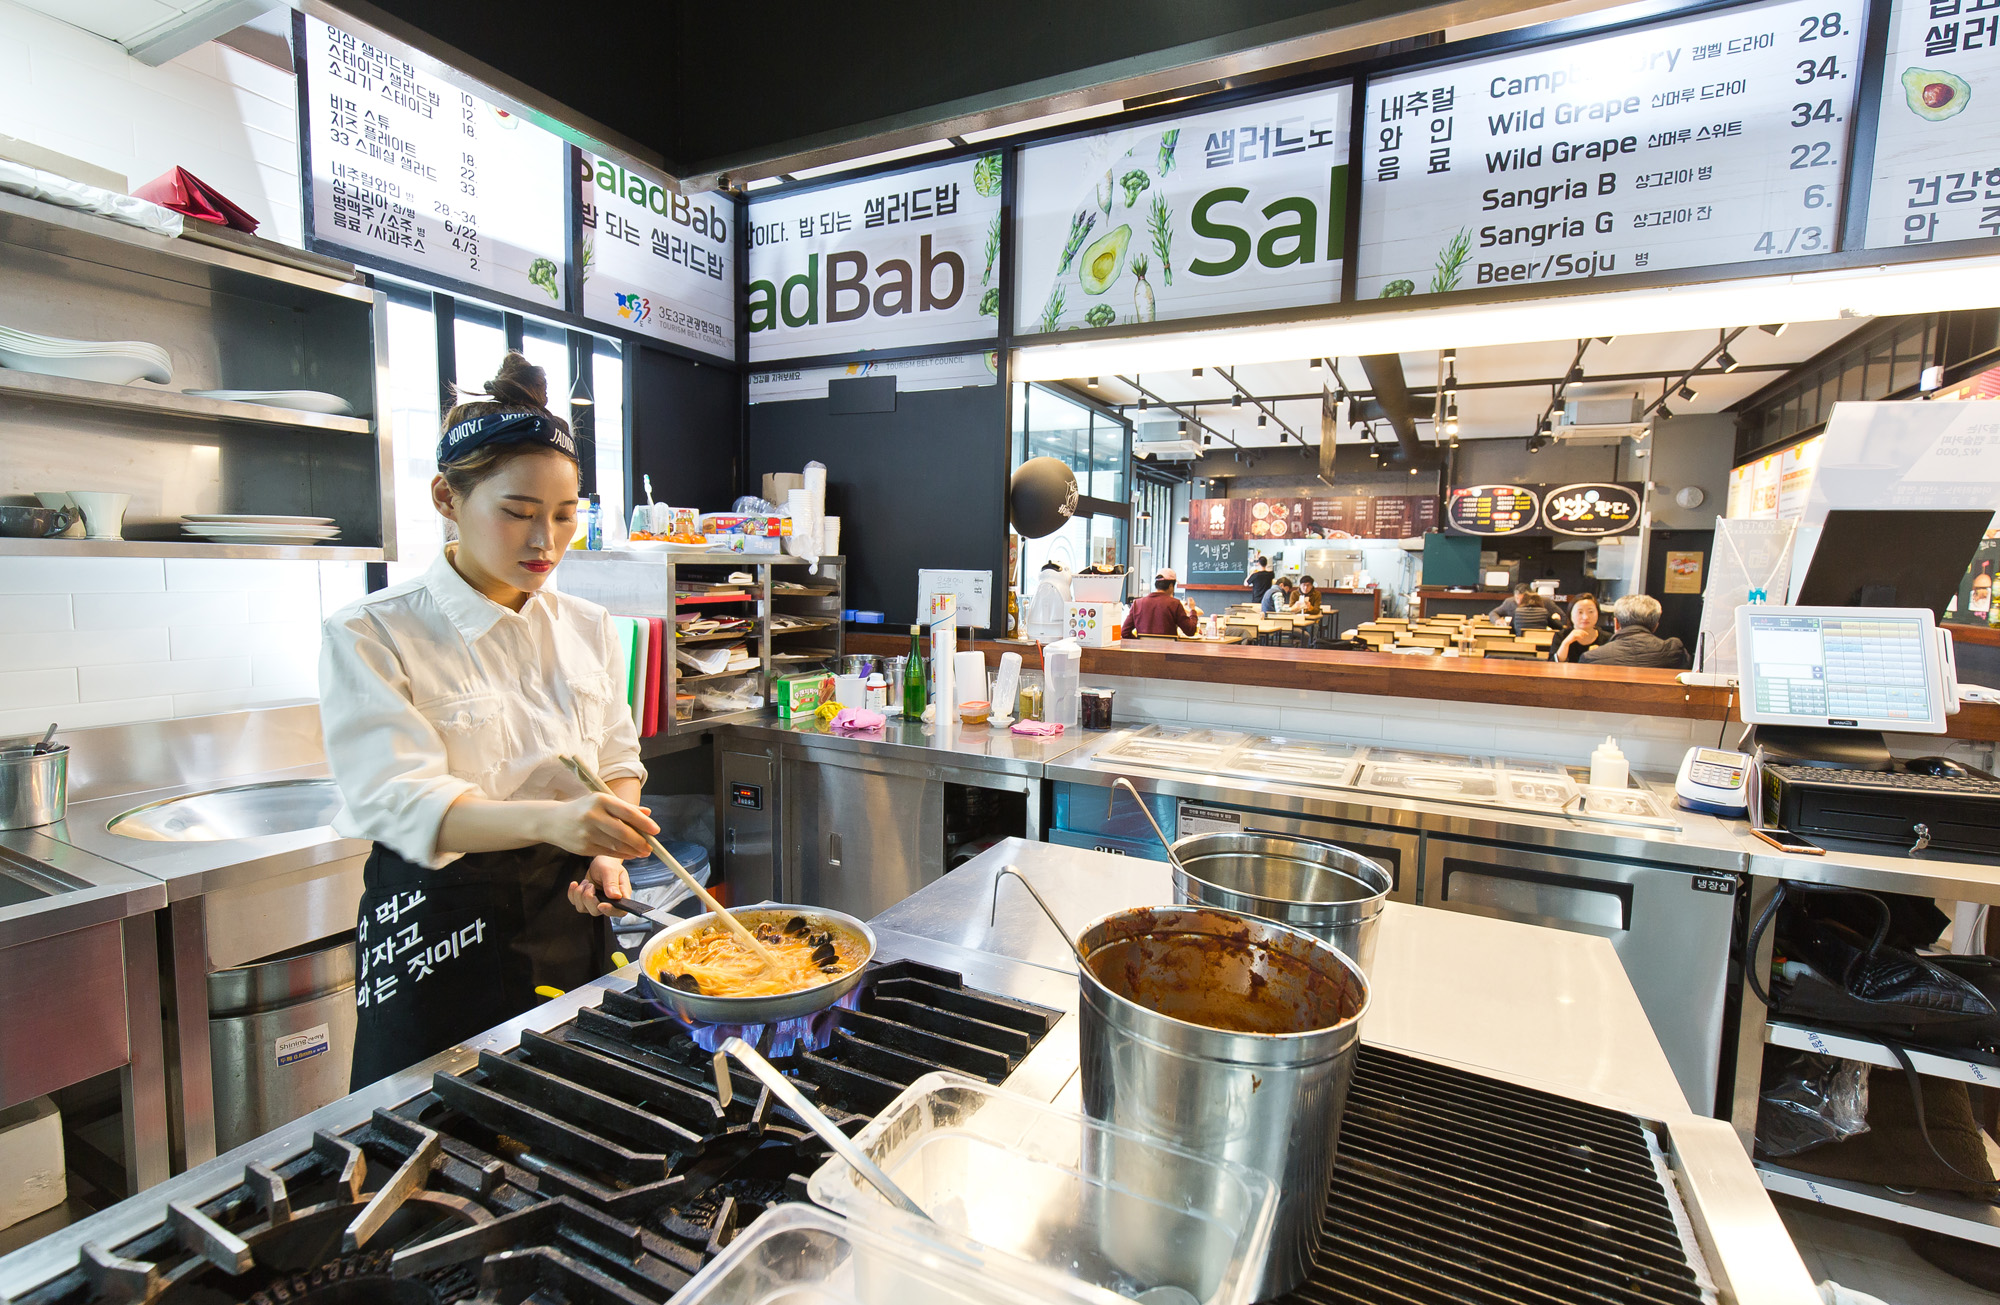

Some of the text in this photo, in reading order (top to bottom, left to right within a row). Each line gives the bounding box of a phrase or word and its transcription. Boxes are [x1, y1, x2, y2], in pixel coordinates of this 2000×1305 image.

[327, 25, 476, 110] 인삼 샐러드밥 10.
[1691, 41, 1722, 62] 캠벨
[1726, 32, 1775, 55] 드라이
[1798, 11, 1850, 44] 28.
[327, 43, 477, 124] 스테이크 샐러드밥 12.
[328, 60, 477, 140] 소고기 스테이크 18.
[1380, 84, 1455, 123] 내추럴
[1488, 55, 1848, 137] Wild Grape 산머루 드라이 34.
[330, 93, 477, 169] 비프 스튜 18.
[330, 110, 478, 184] 치즈 플레이트 22.
[1485, 98, 1843, 174] Wild Grape 산머루 스위트 34.
[330, 128, 478, 199] 33 스페셜 샐러드 33.
[331, 160, 401, 199] 네추럴와인
[1482, 177, 1588, 212] Sangria
[1597, 172, 1617, 196] B
[1697, 164, 1713, 181] 병
[1789, 141, 1838, 170] 22.
[332, 178, 480, 243] 샹그리아 잔/병 6./22.
[332, 194, 480, 258] 병맥주 /소주 병 4./3.
[333, 211, 481, 272] 음료 /사과주스 2.
[799, 216, 815, 239] 밥
[820, 210, 852, 235] 되는
[864, 182, 960, 229] 샐러드밥
[1188, 164, 1349, 277] Sal
[1480, 216, 1585, 248] Sangria
[1595, 211, 1614, 235] G
[1697, 205, 1713, 221] 잔
[1803, 184, 1833, 209] 6.
[605, 211, 641, 247] 되는
[651, 227, 724, 281] 샐러드밥
[1477, 226, 1829, 285] Beer/Soju 병 4./3.
[658, 305, 722, 338] 3도3군관광협의회
[659, 320, 687, 336] TOURISM
[687, 329, 702, 340] BELT
[916, 360, 934, 368] BELT
[934, 356, 965, 367] COUNCIL
[448, 418, 485, 446] J'ADIOR
[1595, 500, 1631, 518] 판다
[1697, 879, 1729, 893] 냉장실
[407, 917, 487, 982] 짓이다
[279, 1039, 307, 1052] Shining
[1968, 1062, 1988, 1081] steel
